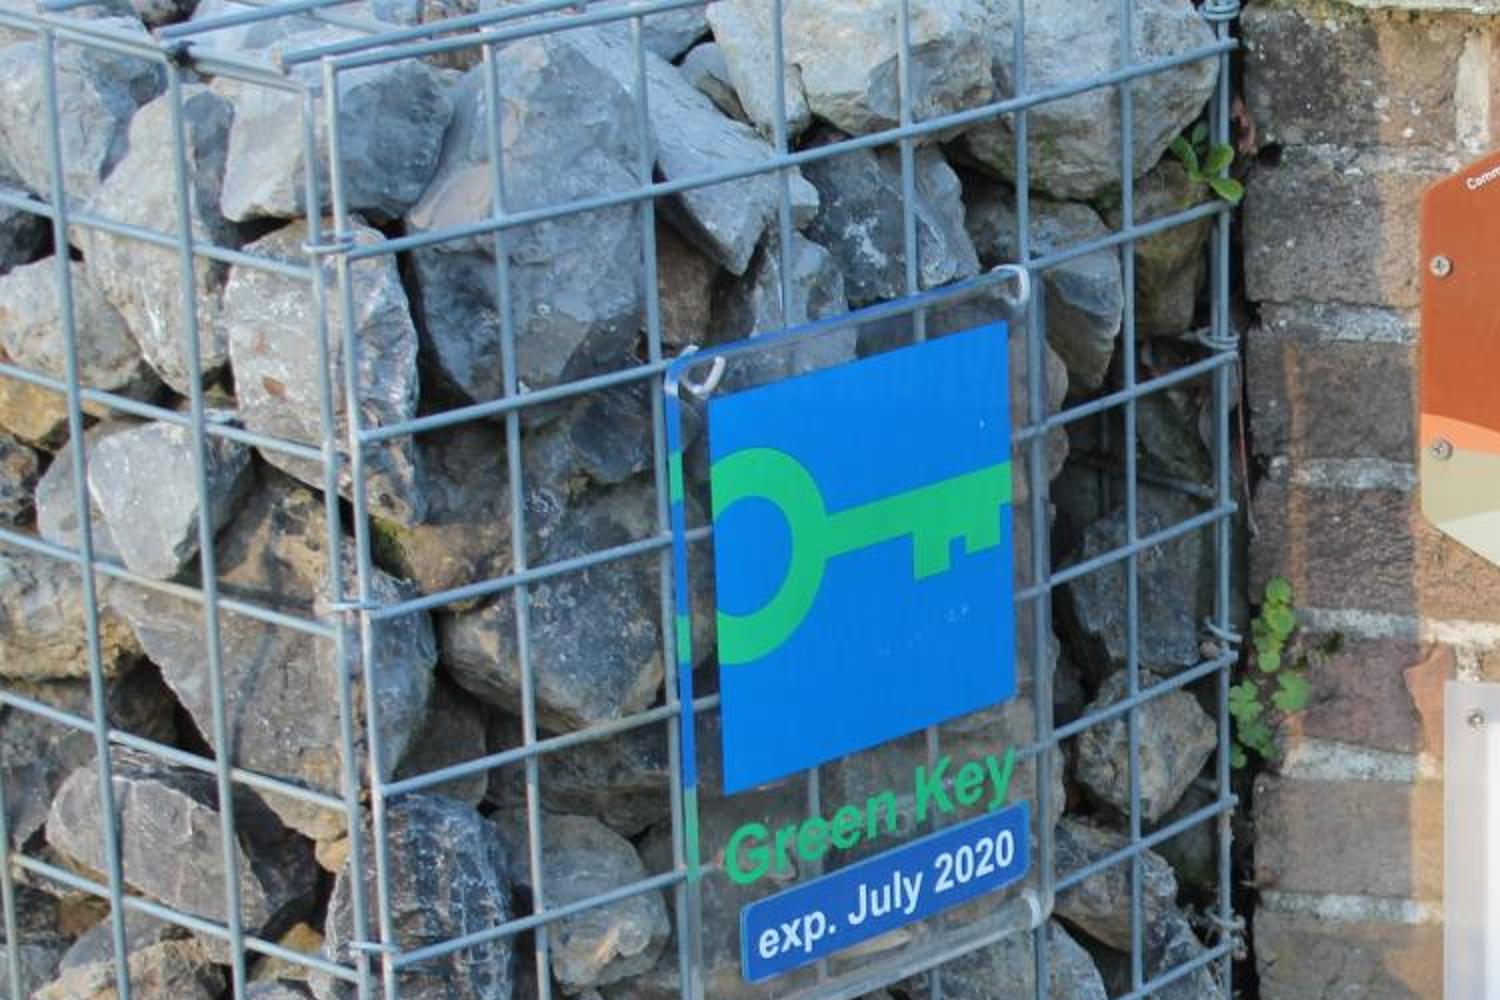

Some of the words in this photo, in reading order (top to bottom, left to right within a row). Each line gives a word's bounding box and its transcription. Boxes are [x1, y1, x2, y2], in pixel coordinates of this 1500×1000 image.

[724, 790, 896, 885] Green
[915, 747, 1015, 822] Key
[758, 910, 836, 959] exp.
[848, 871, 923, 925] July
[934, 830, 1014, 892] 2020
